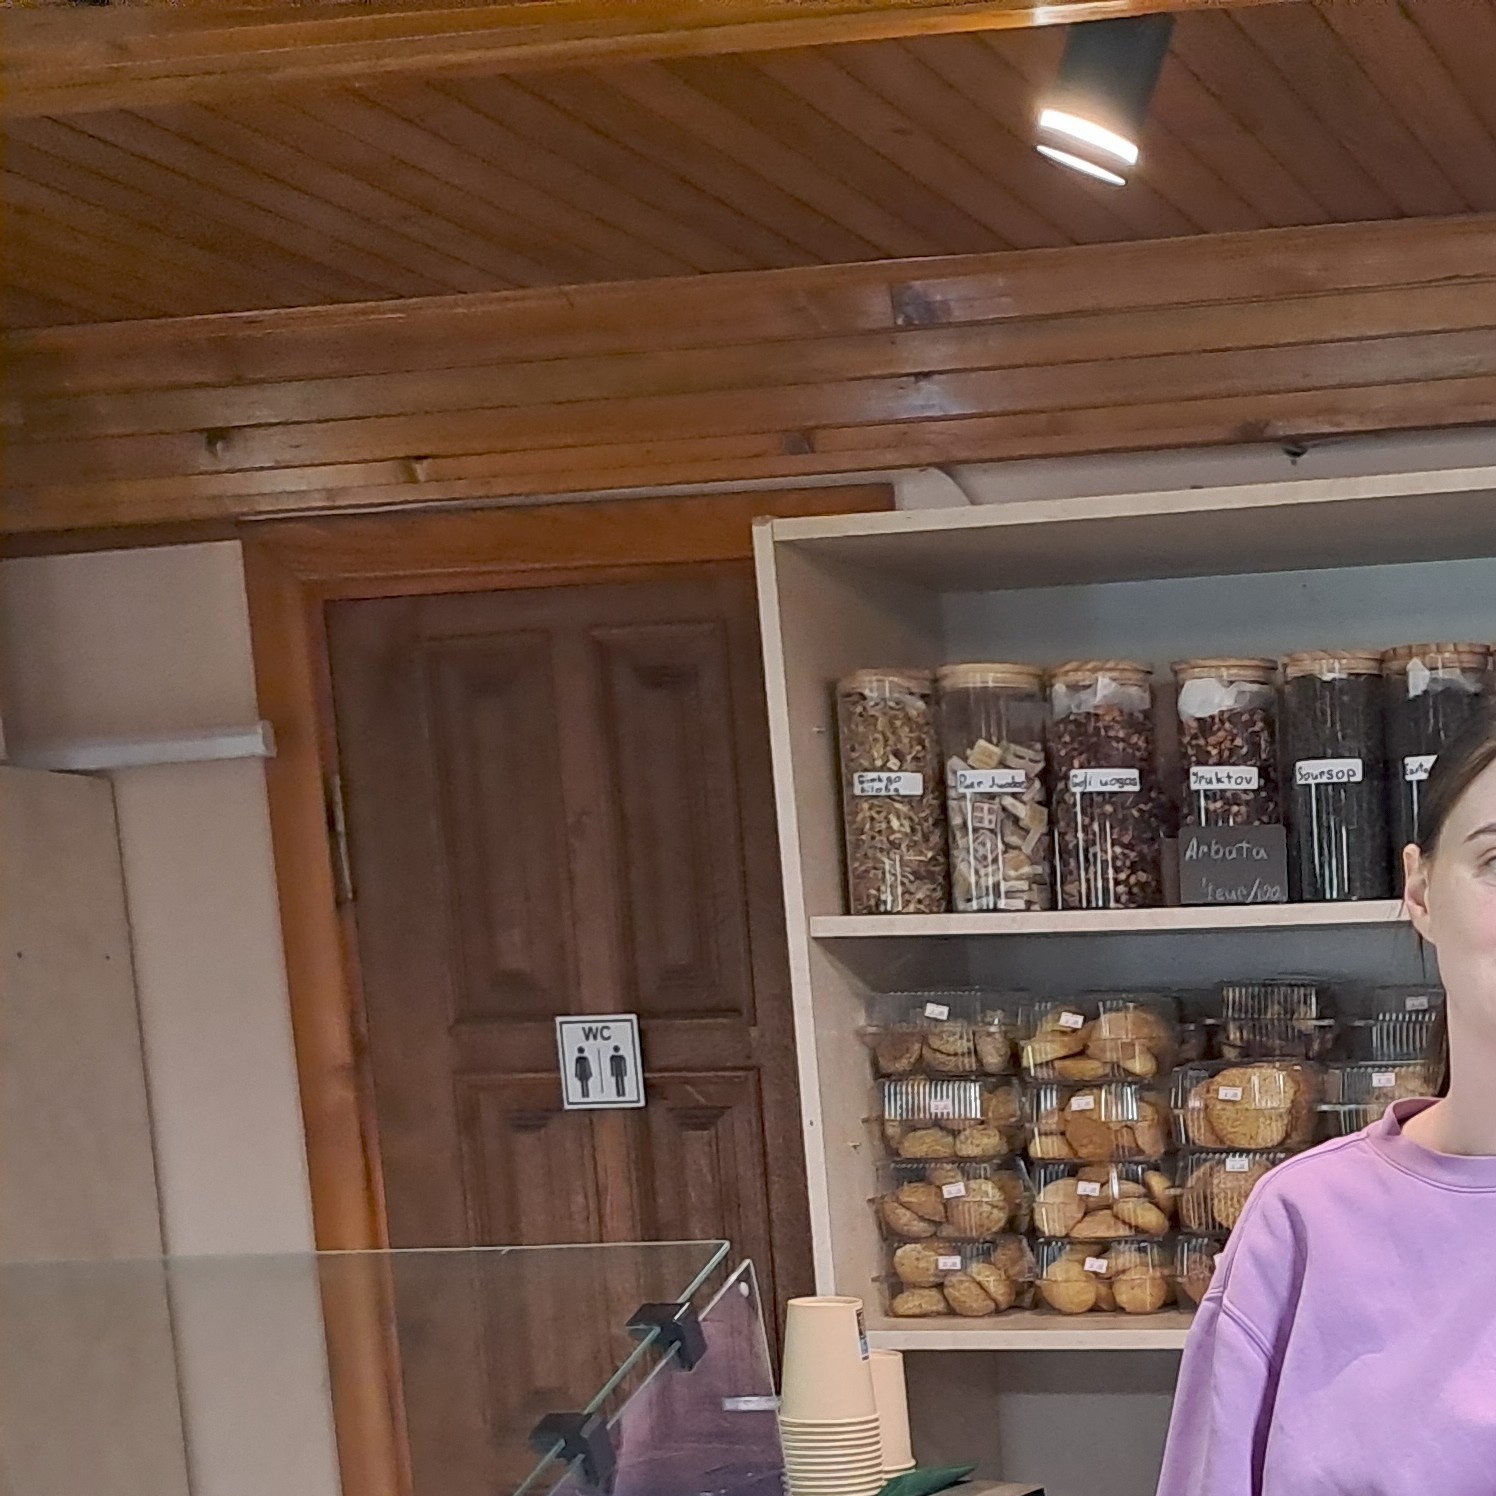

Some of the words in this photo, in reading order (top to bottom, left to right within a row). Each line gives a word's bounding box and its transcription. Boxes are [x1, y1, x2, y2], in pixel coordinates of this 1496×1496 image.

[1298, 767, 1357, 784] Soursop
[1185, 836, 1268, 861] Arbata
[582, 1025, 612, 1042] WC
